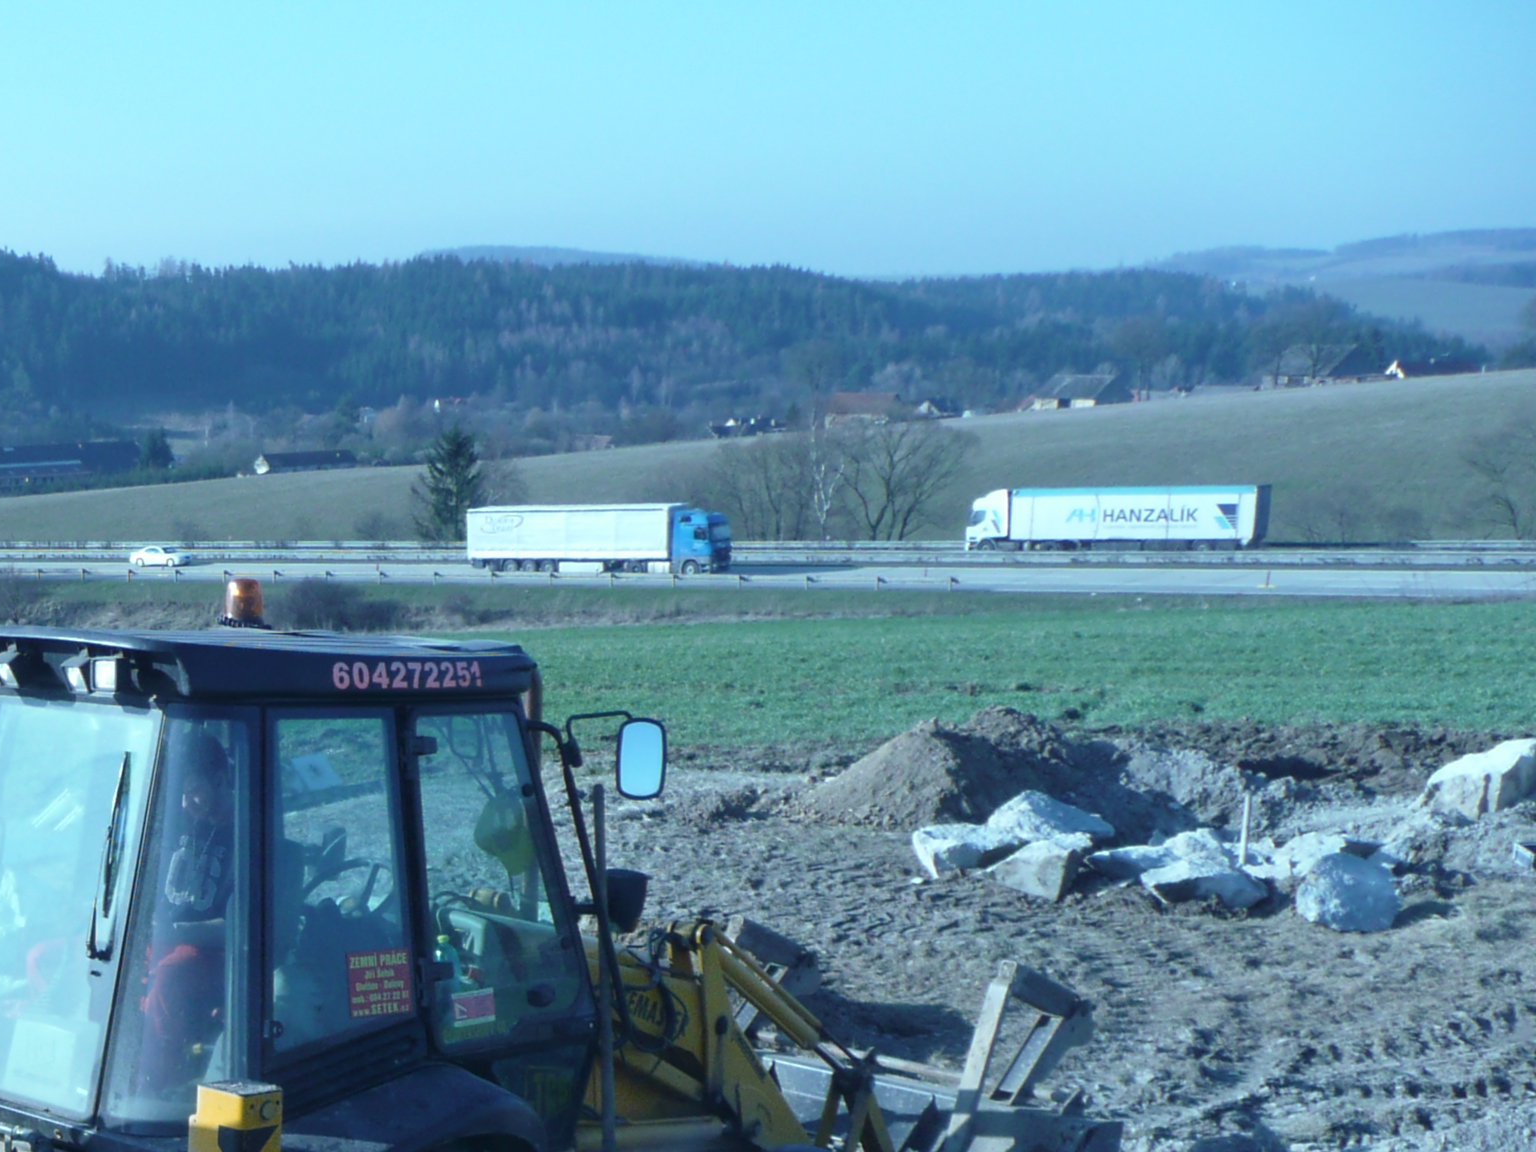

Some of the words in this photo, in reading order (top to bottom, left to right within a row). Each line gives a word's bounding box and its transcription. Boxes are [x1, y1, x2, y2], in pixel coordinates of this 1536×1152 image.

[1102, 505, 1199, 523] HANZALÍK
[332, 661, 483, 689] 604272251
[380, 950, 407, 966] PRÁCE
